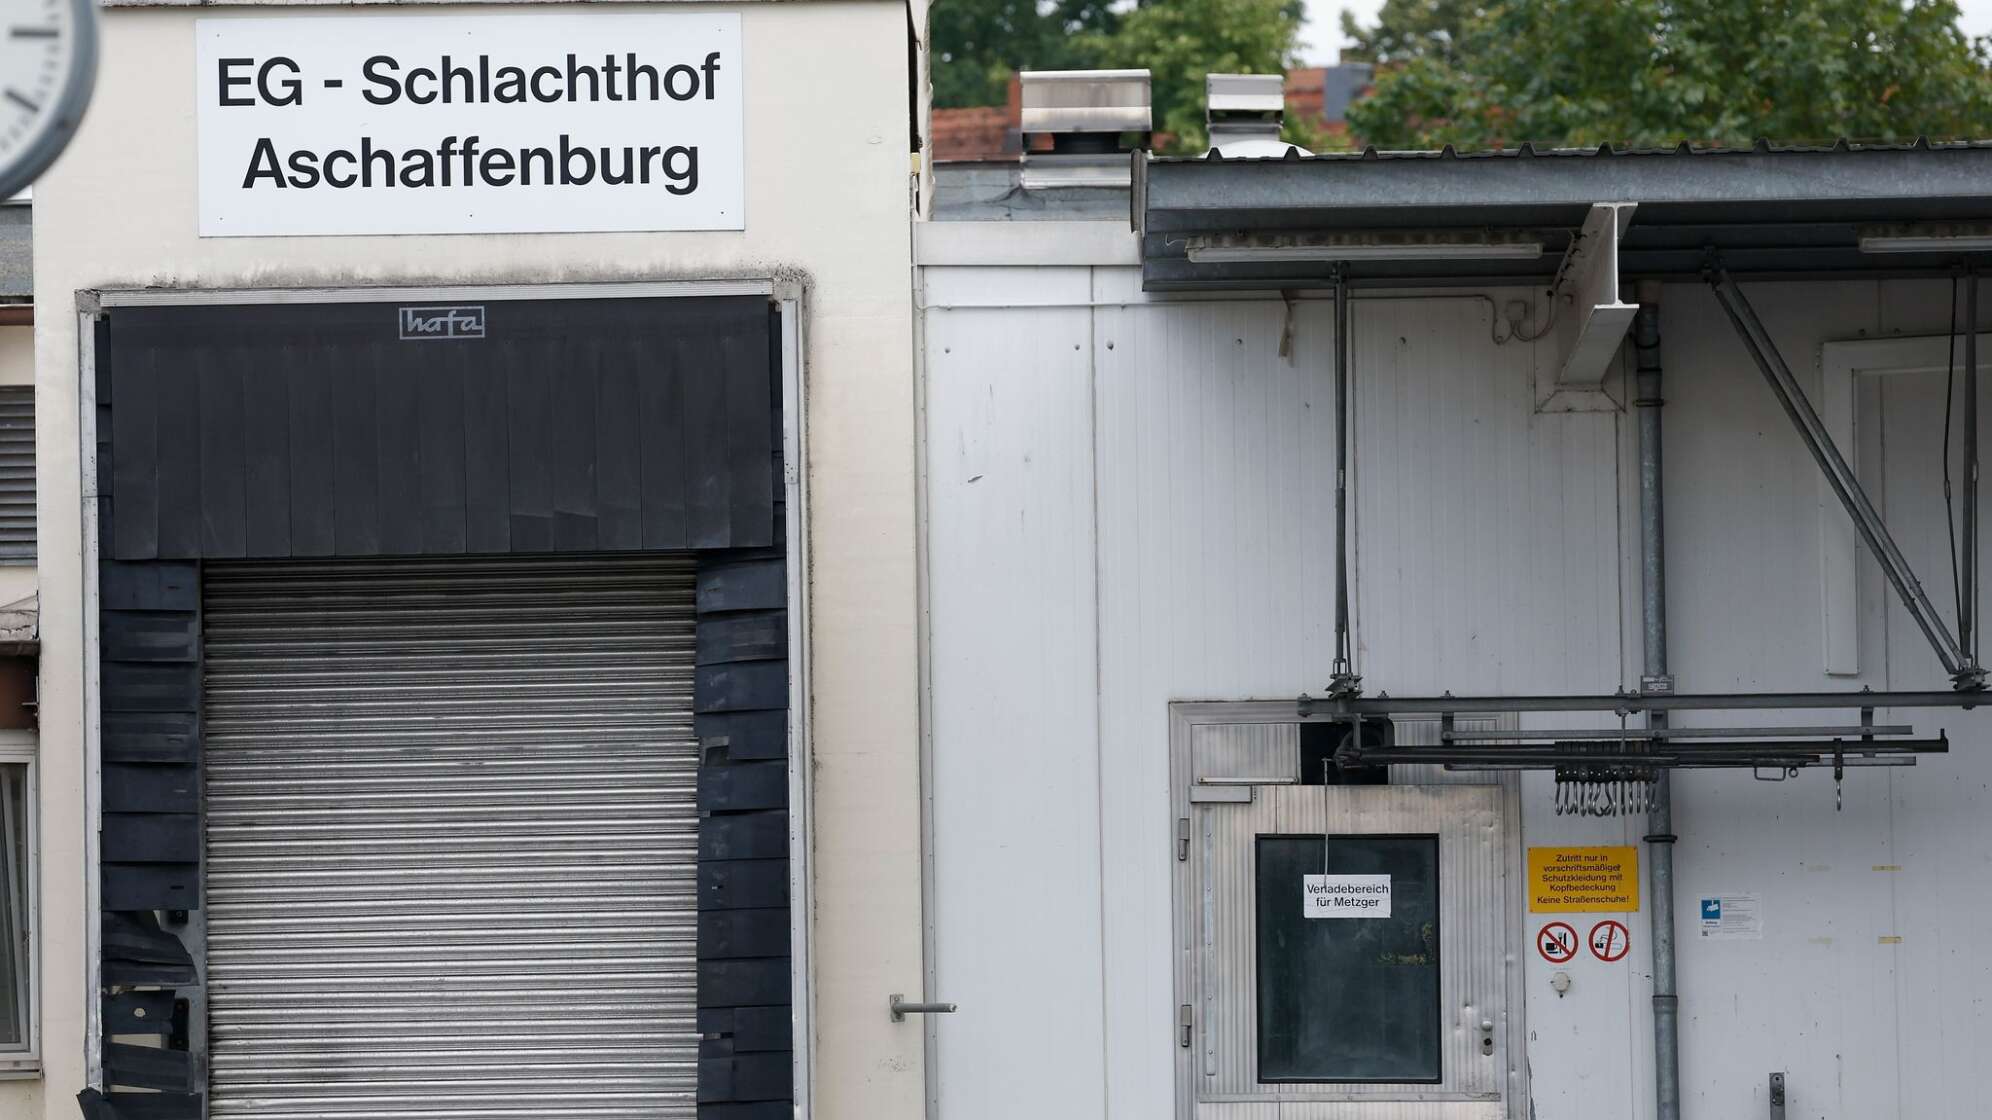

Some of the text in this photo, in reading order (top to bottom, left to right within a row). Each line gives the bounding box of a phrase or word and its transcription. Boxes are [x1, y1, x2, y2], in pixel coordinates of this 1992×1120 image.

[218, 51, 721, 107] EG - Schlachthof
[242, 134, 699, 196] Aschaffenburg
[1556, 854, 1582, 862] Zutritt
[1600, 854, 1608, 862] in
[1542, 874, 1623, 883] Schutzkleidung mit
[1306, 884, 1389, 894] Verladebereich
[1550, 884, 1616, 893] Kopfbedeckung
[1316, 896, 1380, 909] für Metzger
[1537, 895, 1629, 904] Keine Straßenschuhe!
